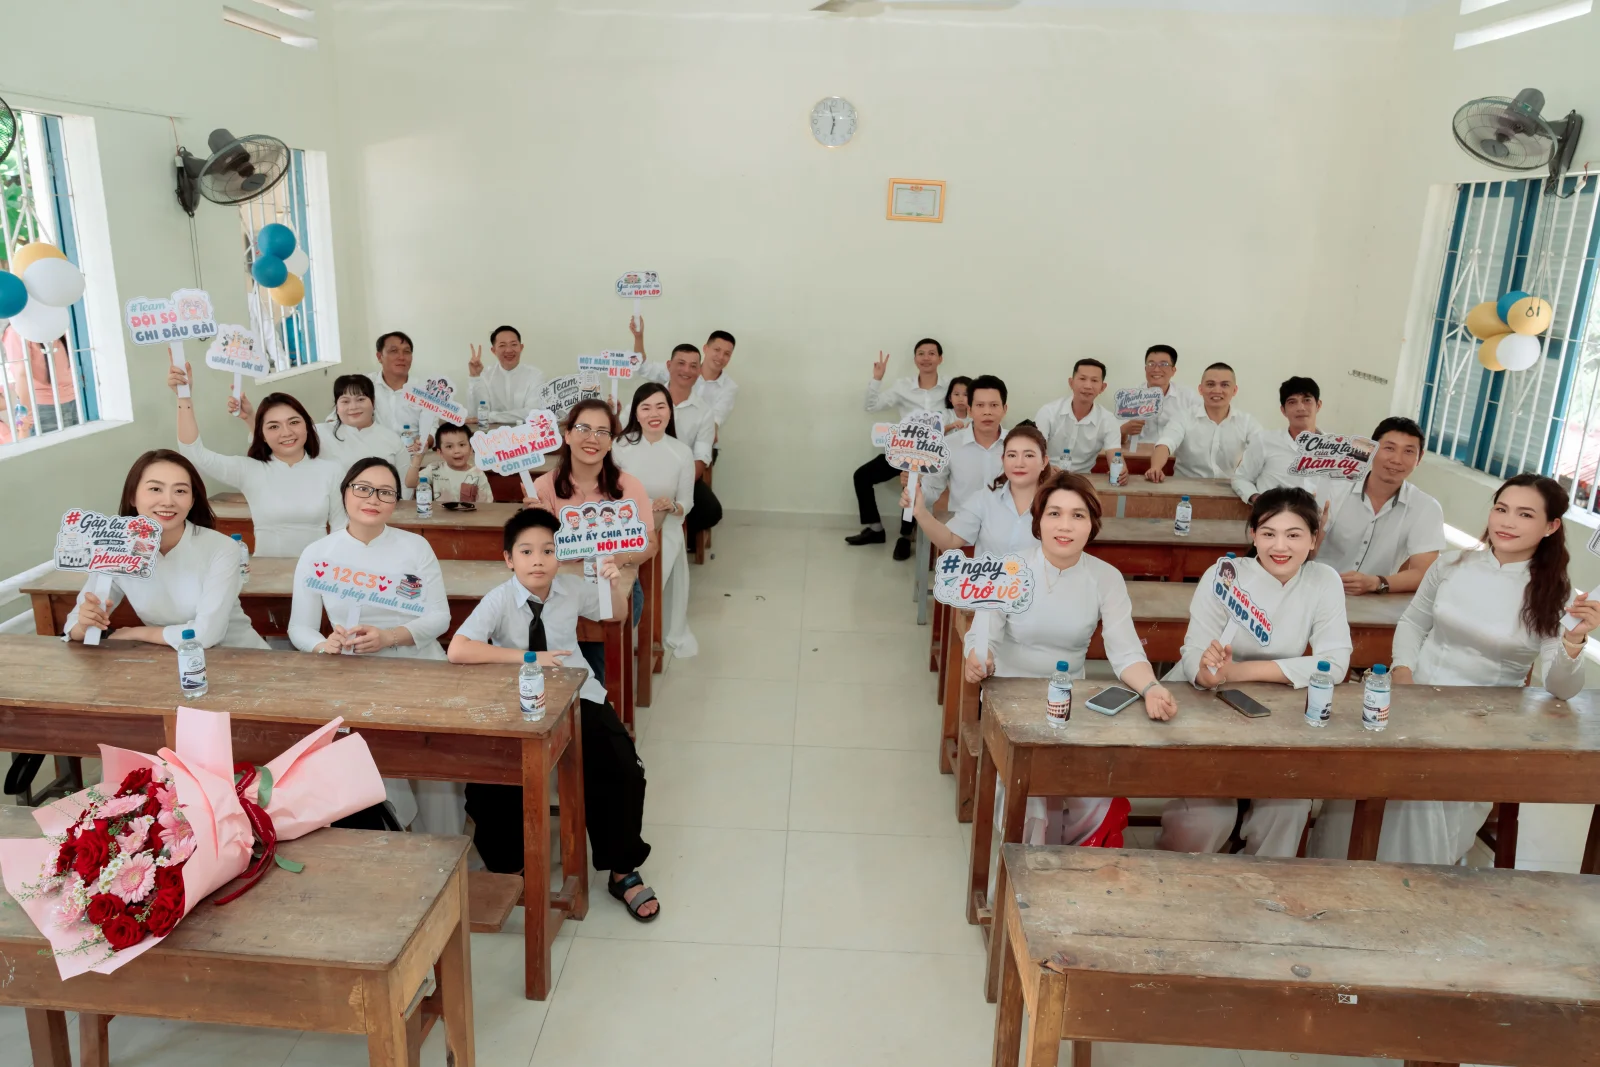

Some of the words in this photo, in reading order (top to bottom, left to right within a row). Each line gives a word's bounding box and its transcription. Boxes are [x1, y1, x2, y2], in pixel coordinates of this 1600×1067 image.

[130, 301, 166, 313] #Team
[131, 313, 157, 328] ĐỘI
[135, 331, 159, 342] GHI
[192, 321, 214, 334] BÀI
[579, 357, 592, 365] MỘT
[594, 358, 610, 366] HÀNH
[611, 359, 630, 367] TRÌNH
[541, 377, 578, 398] #Team
[418, 396, 463, 424] 2003-2006
[901, 424, 930, 441] Hội
[495, 444, 528, 462] Thanh
[528, 436, 558, 453] Xuân
[890, 435, 914, 450] bạn
[916, 438, 945, 458] thân
[1299, 433, 1343, 456] #Chúng
[1340, 441, 1351, 454] ta
[501, 459, 520, 473] còn
[521, 454, 541, 467] mãi
[1337, 456, 1360, 476] ấy
[65, 511, 107, 534] #Gặp
[91, 528, 128, 539] nhau
[558, 533, 583, 545] NGÀY
[585, 529, 598, 541] ẤY
[601, 529, 622, 539] CHIA
[624, 527, 642, 536] TAY
[559, 547, 578, 557] Hôm
[579, 546, 595, 554] nay
[597, 538, 617, 552] HỘI
[620, 535, 645, 549] NGỘ
[106, 545, 128, 553] mùa
[88, 551, 141, 573] phượng
[941, 554, 1007, 582] #ngày
[332, 566, 378, 589] 12C3
[959, 577, 995, 600] trở
[996, 577, 1022, 600] về
[340, 587, 367, 603] ghép
[368, 591, 399, 608] thanh
[400, 601, 425, 613] xuân
[1232, 585, 1250, 608] TRỐN
[1215, 582, 1227, 601] ĐI
[1228, 595, 1249, 621] HỌP
[1249, 618, 1269, 643] LỚP
